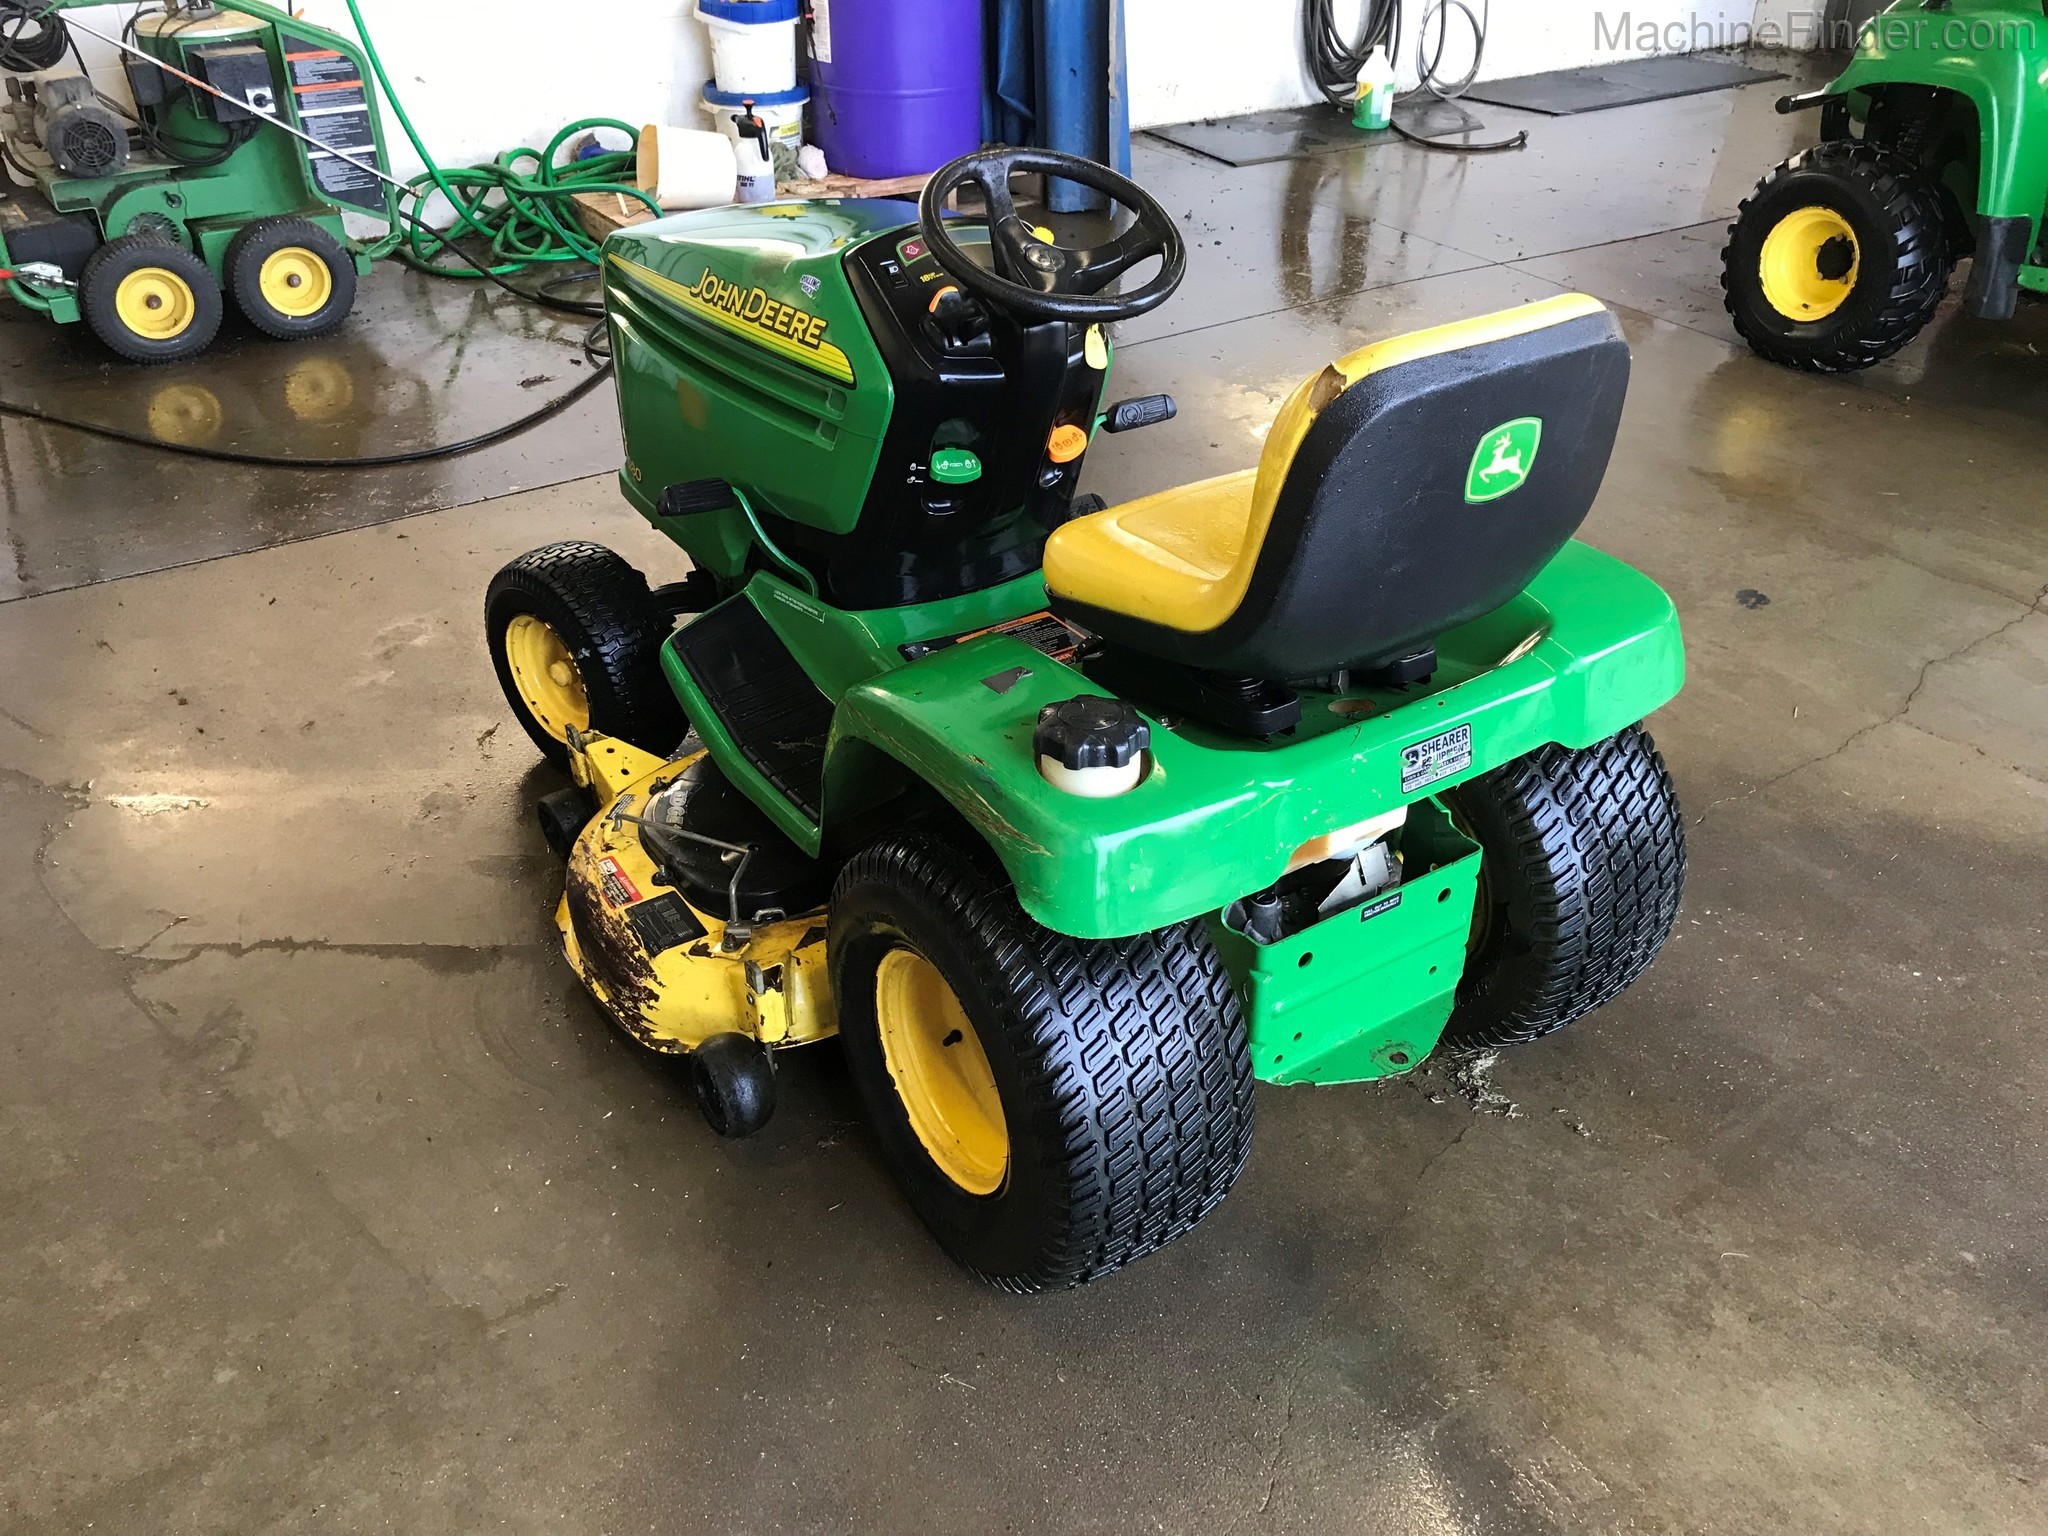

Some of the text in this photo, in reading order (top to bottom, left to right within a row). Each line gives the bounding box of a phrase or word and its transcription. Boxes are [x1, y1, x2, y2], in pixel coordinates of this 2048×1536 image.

[690, 266, 828, 350] JOHN DEERE
[1421, 728, 1468, 757] SHEARER
